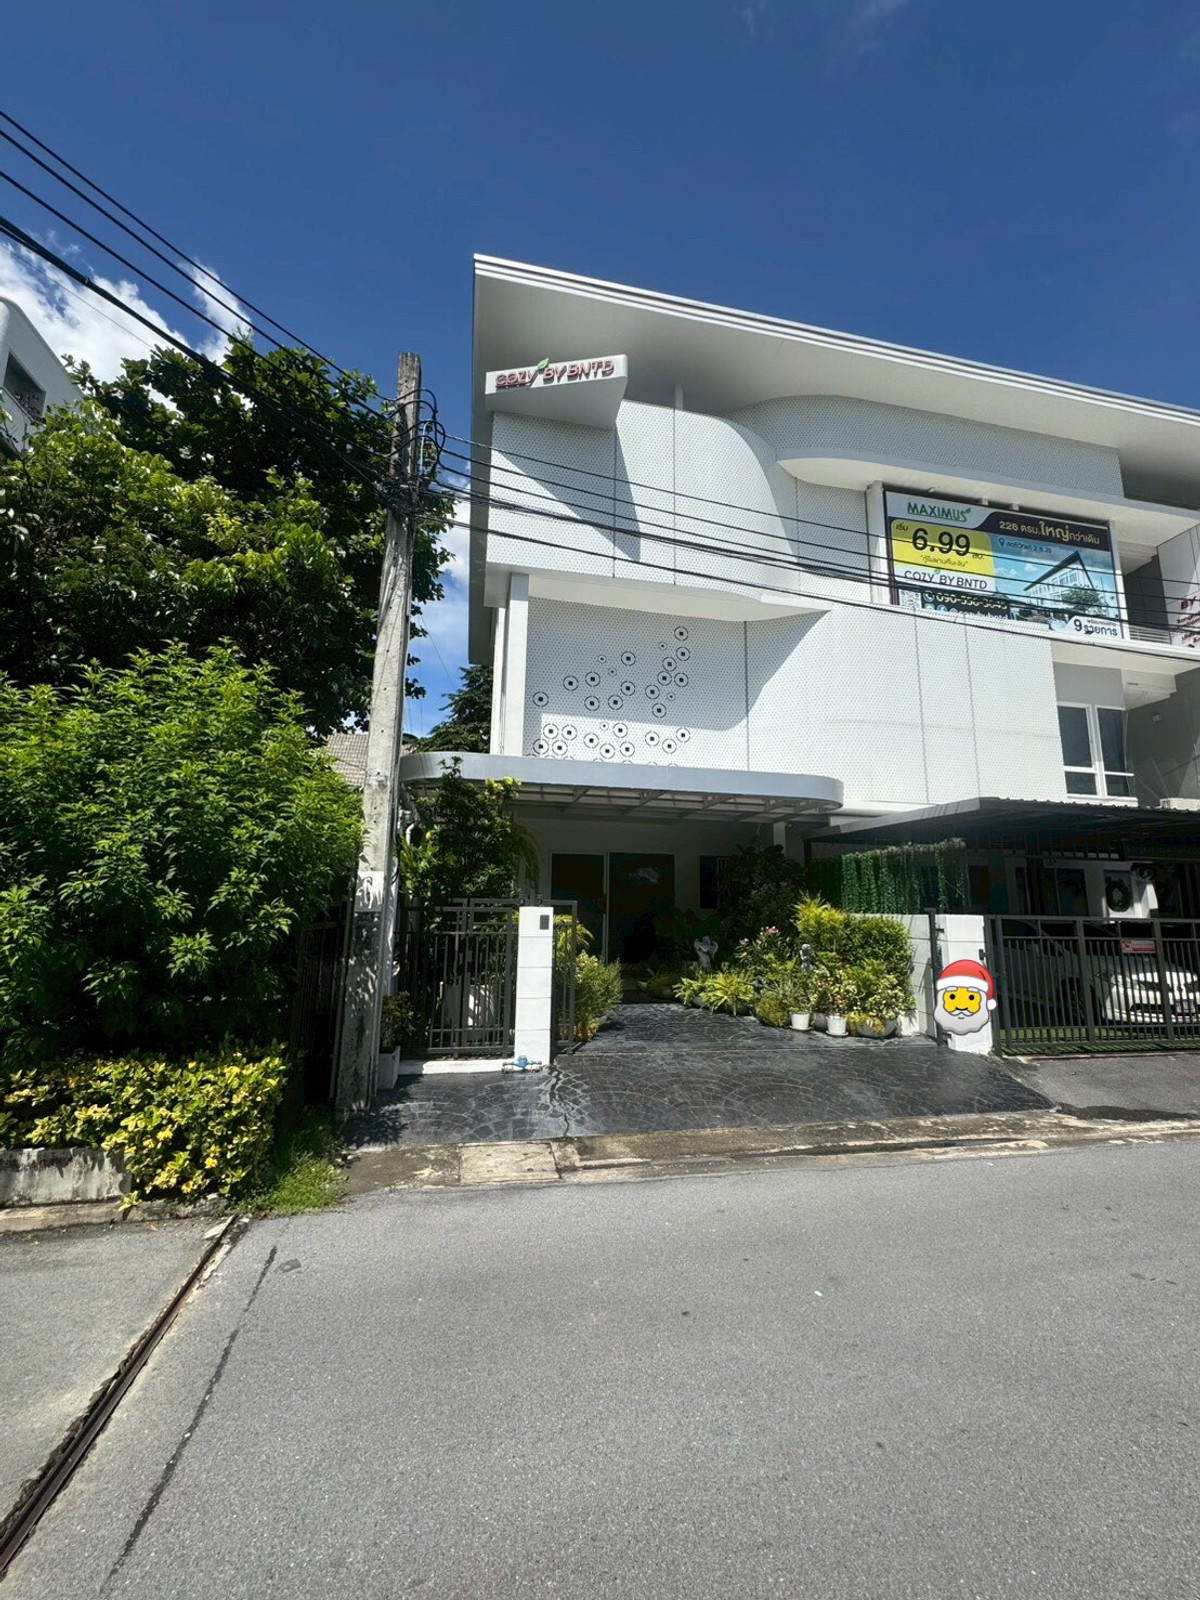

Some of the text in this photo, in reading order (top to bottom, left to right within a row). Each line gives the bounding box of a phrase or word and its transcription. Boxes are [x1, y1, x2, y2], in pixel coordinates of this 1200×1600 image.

[543, 366, 565, 383] BY
[567, 360, 615, 380] BNTD
[907, 501, 971, 523] MAXIMUS
[912, 527, 970, 557] 6.99
[904, 570, 988, 590] COZY BY BNTD
[1073, 618, 1083, 633] 9
